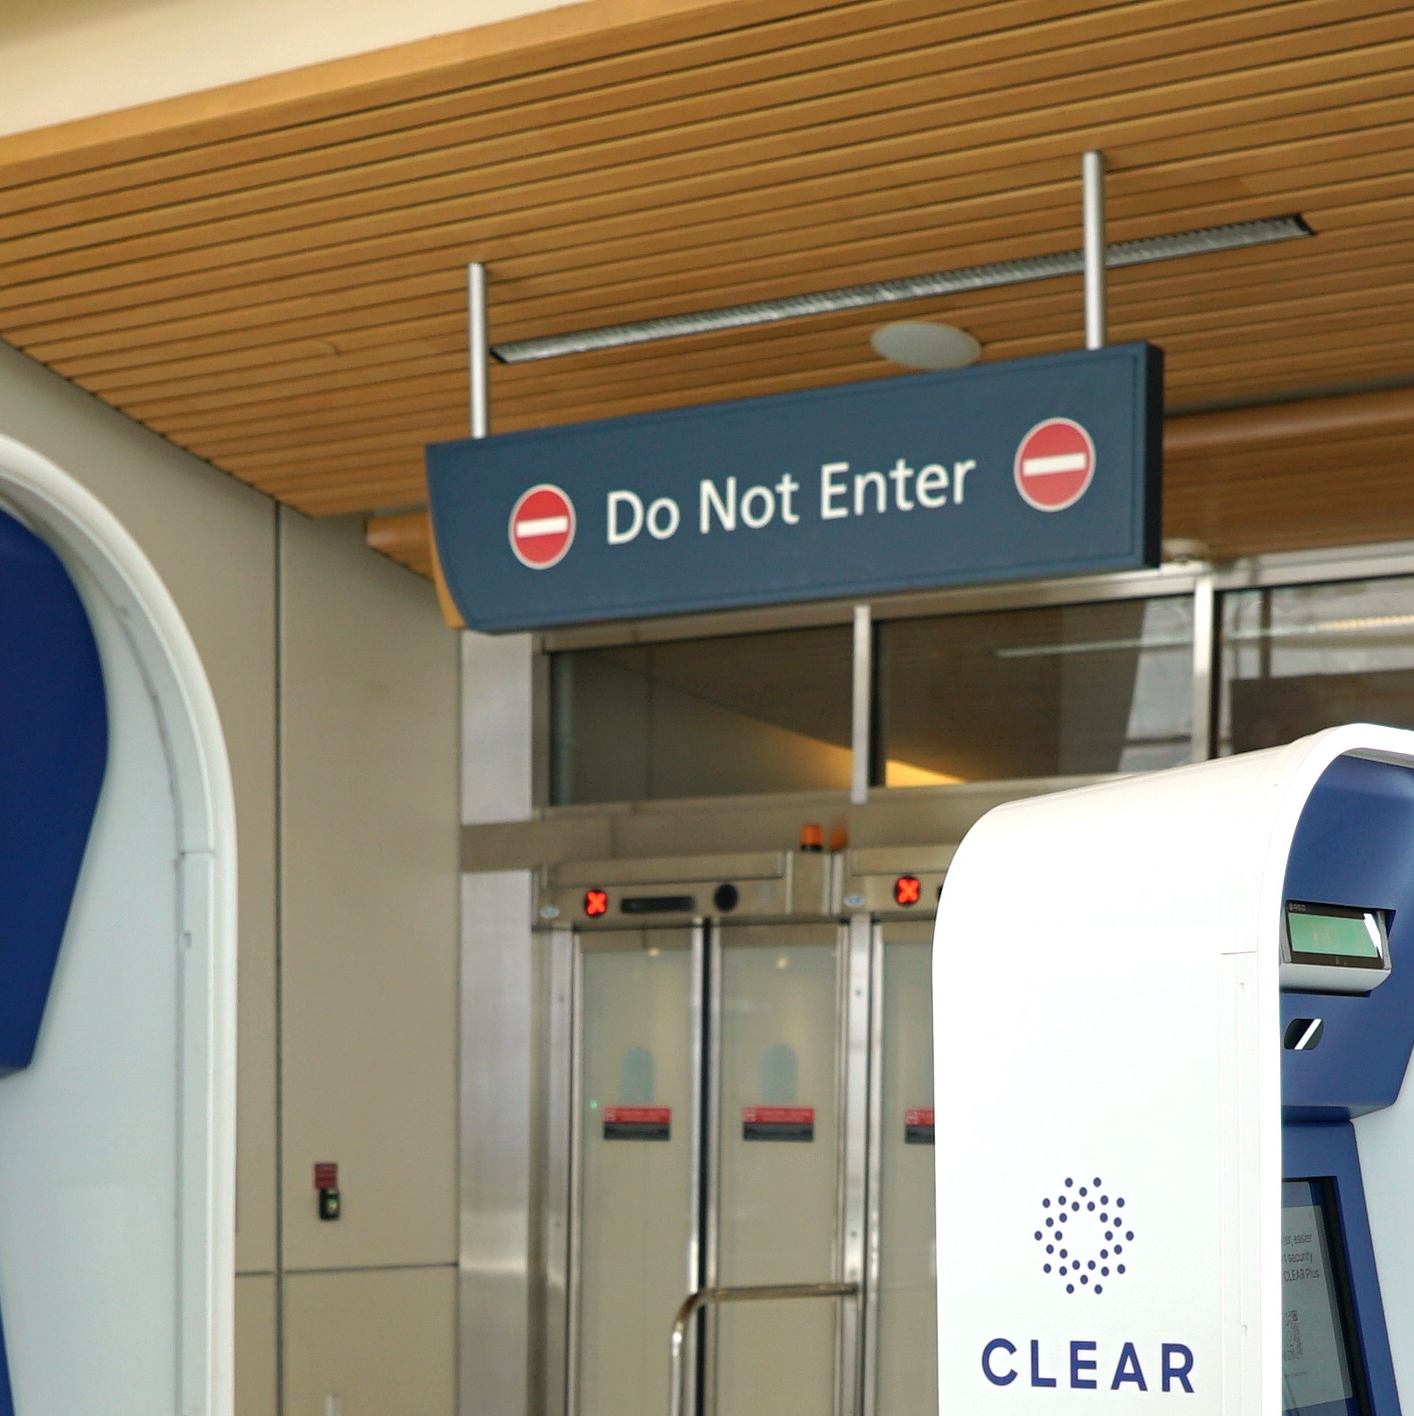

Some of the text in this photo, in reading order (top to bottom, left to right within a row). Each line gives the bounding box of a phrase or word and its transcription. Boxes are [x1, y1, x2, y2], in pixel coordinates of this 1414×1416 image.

[606, 457, 977, 545] Do Not Enter
[981, 1337, 1195, 1394] CLEAR
